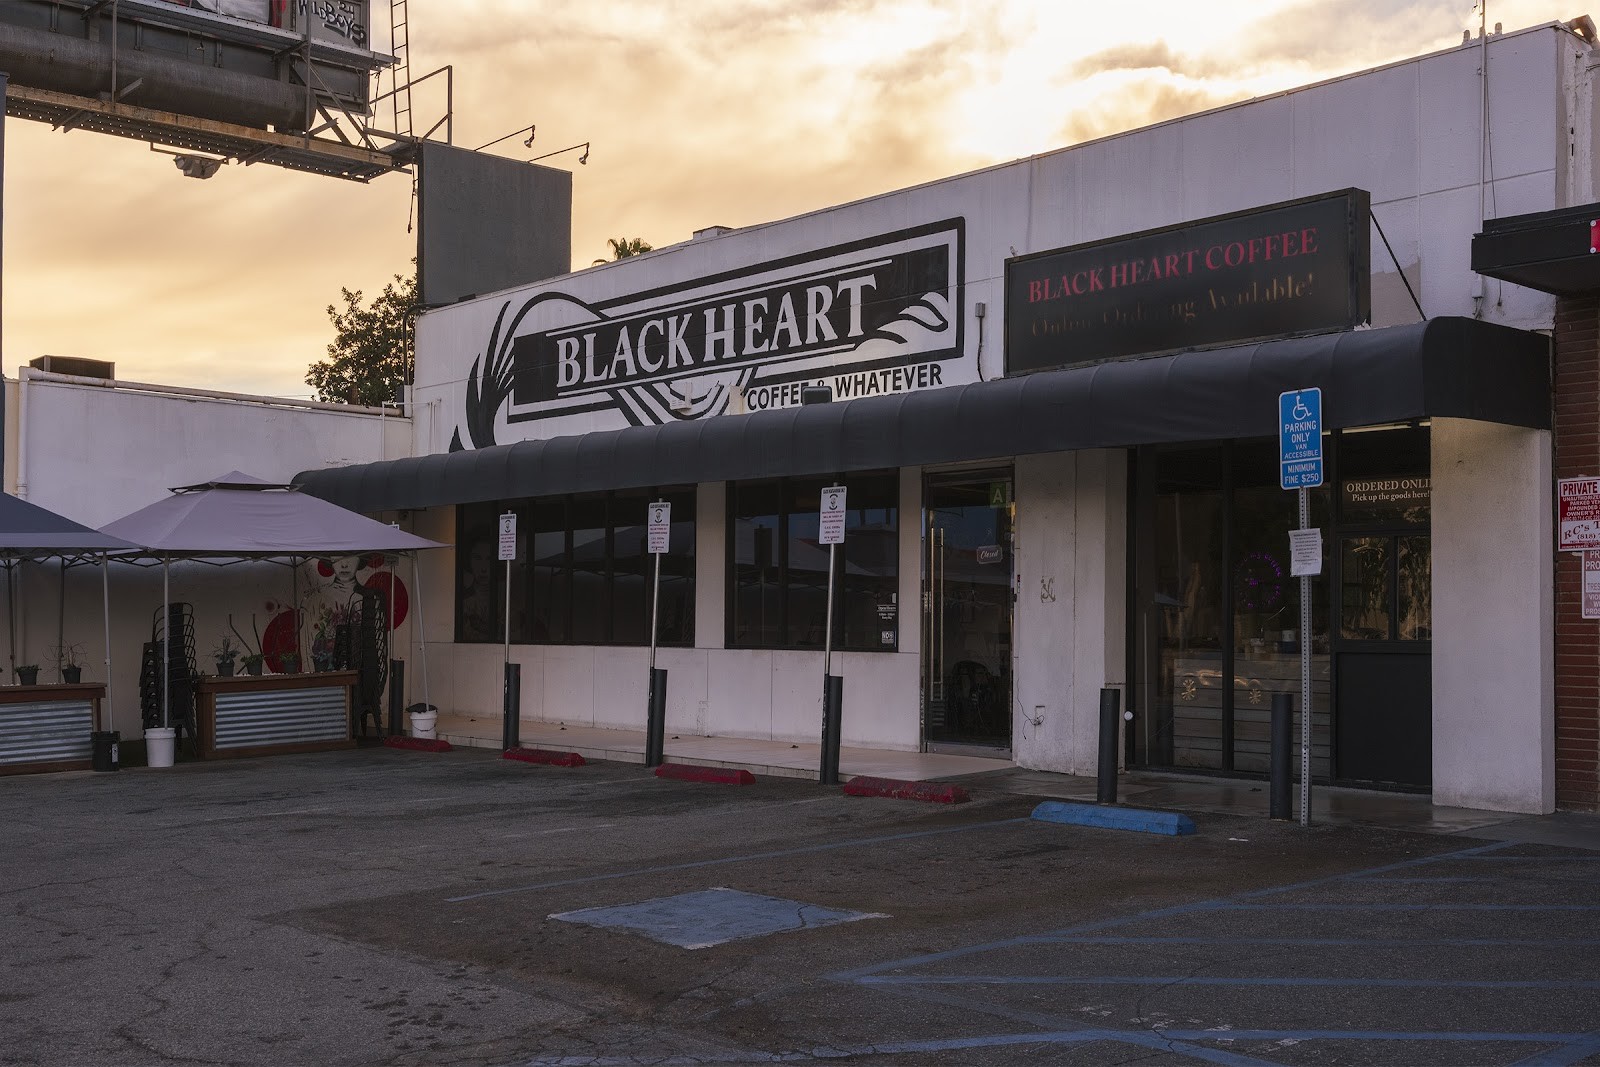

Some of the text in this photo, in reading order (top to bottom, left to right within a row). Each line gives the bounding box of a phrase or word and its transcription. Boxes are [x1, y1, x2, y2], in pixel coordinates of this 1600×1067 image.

[1028, 227, 1319, 303] BLACK HEART COFFEE
[556, 273, 877, 389] BLACK HEART
[834, 363, 943, 398] WHATEVER
[1284, 420, 1317, 433] PARKING
[1291, 432, 1310, 443] ONLY
[1284, 450, 1318, 459] ACCESSIBLE
[1287, 463, 1316, 473] MINIMUM
[1284, 473, 1319, 484] FINE $250
[1346, 479, 1431, 493] ORDERED ONLI
[1563, 482, 1598, 495] PRIVATE
[992, 487, 1003, 504] A
[1352, 490, 1430, 503] Pick up the goods here!
[980, 549, 999, 560] Closed
